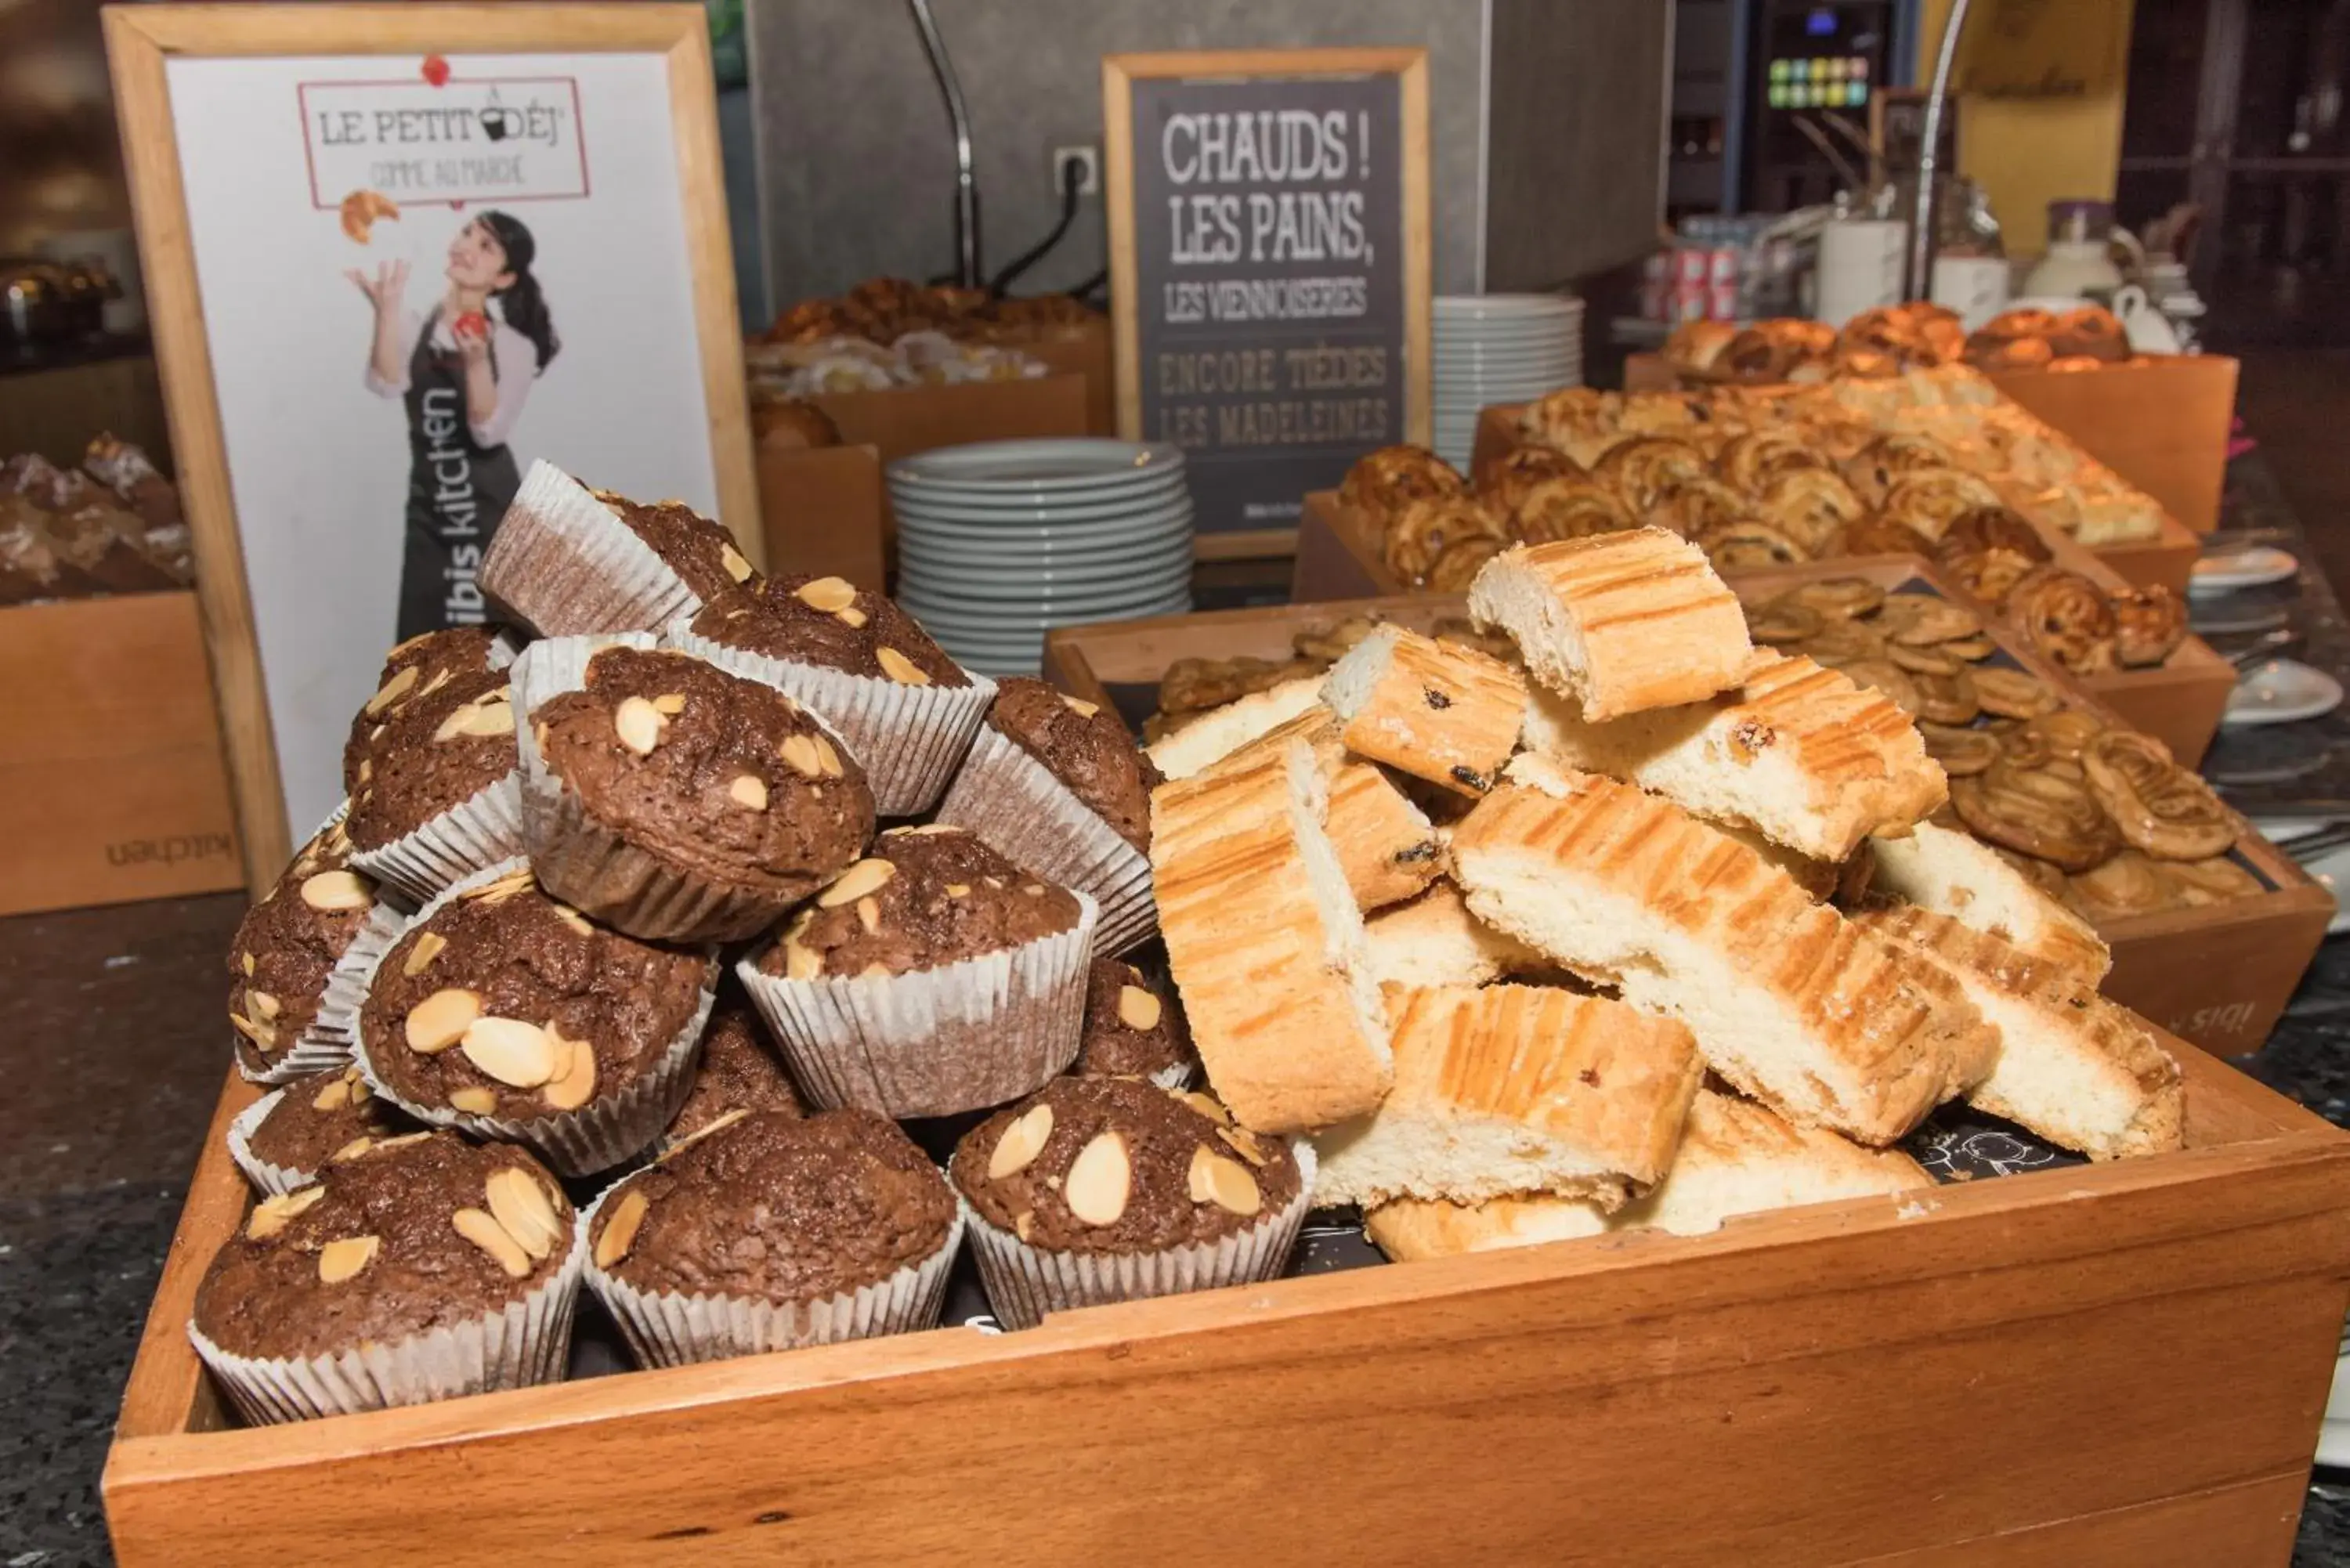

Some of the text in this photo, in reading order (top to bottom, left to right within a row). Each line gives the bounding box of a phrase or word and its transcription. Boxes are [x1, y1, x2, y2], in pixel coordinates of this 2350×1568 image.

[319, 111, 367, 146] LE
[375, 108, 472, 142] PETIT
[1162, 110, 1349, 185] CHAUDS
[1169, 191, 1373, 266] LES PAINS,
[1164, 282, 1204, 323] LES
[1159, 348, 1277, 396] ENCORE
[1160, 397, 1389, 448] LES MADELEINES
[422, 387, 487, 624] ibis kitchen
